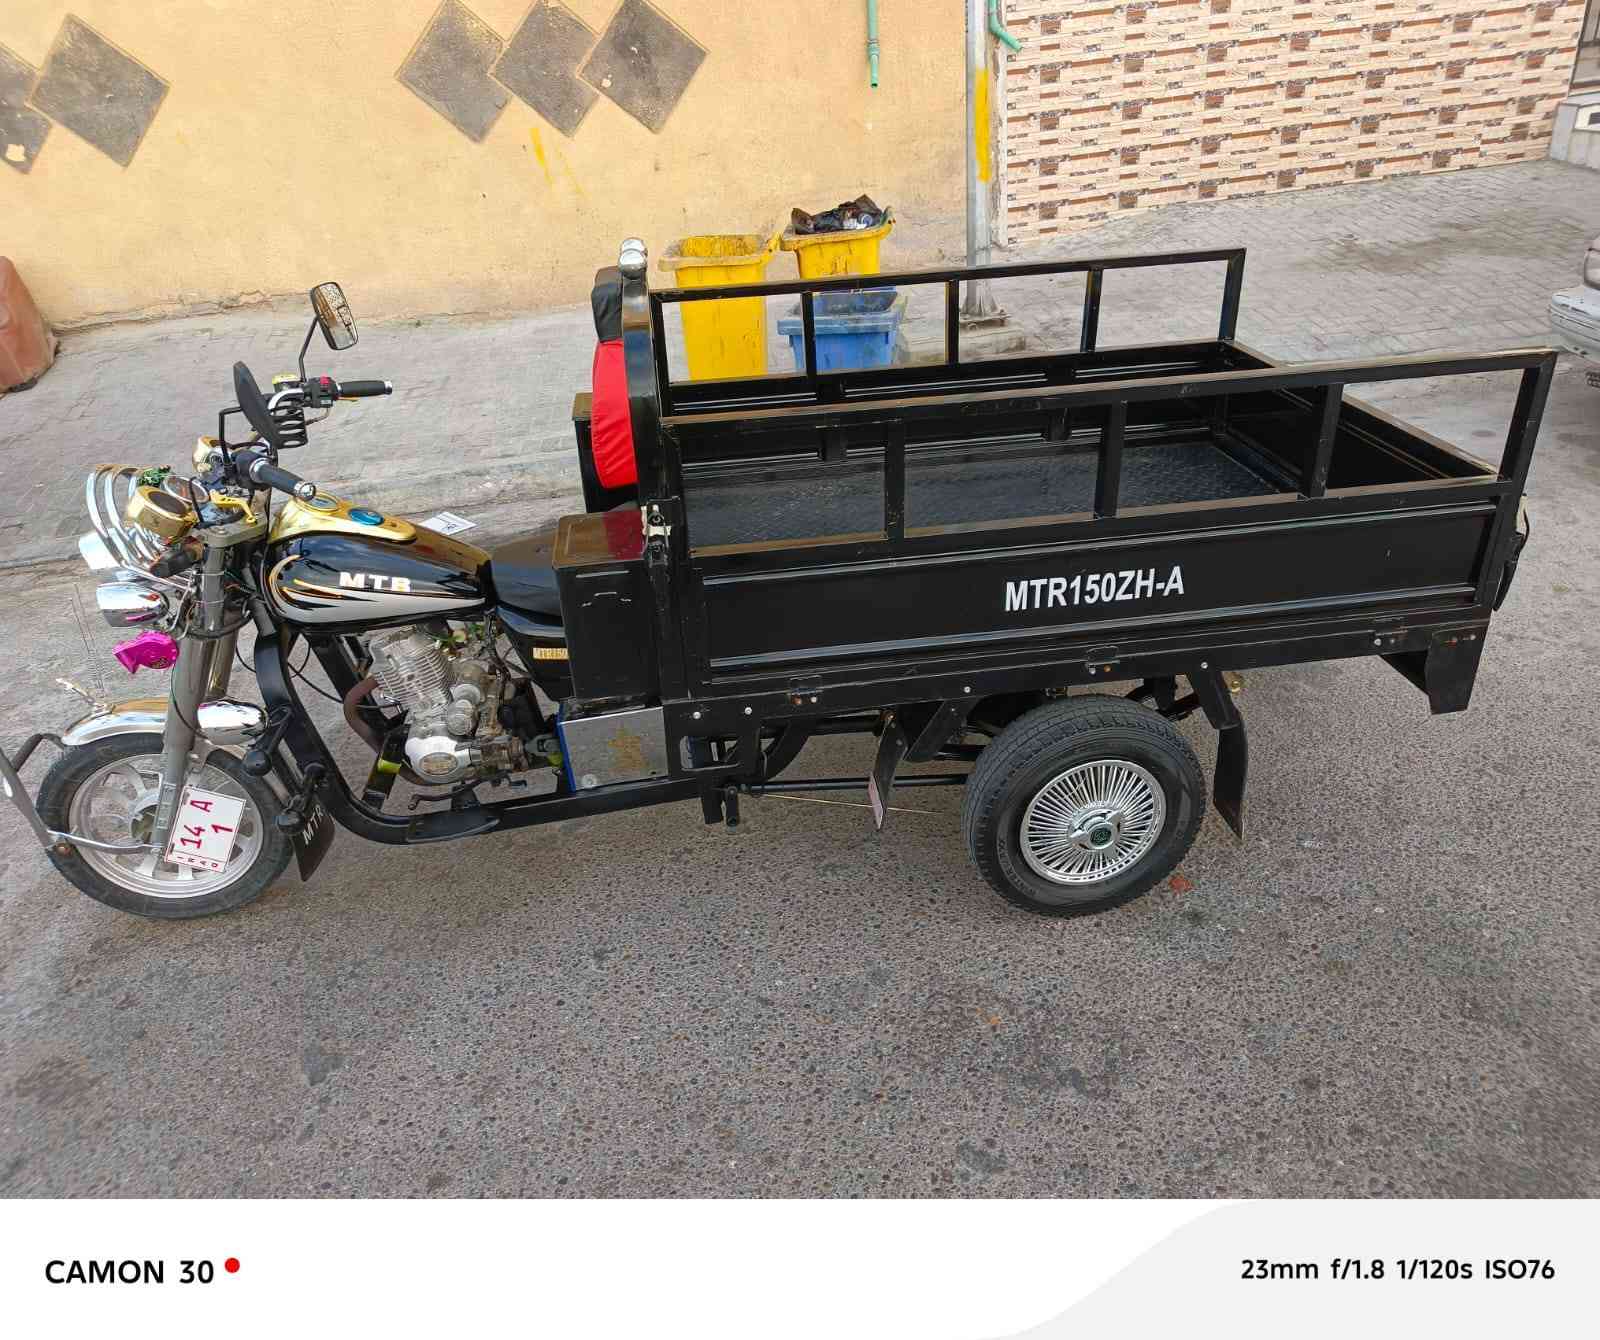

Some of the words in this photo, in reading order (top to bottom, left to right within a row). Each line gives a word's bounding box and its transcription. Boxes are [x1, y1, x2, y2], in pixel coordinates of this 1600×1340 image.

[339, 571, 412, 593] MTR
[1004, 565, 1185, 612] MTR150ZH-A
[190, 800, 213, 813] A
[180, 825, 205, 849] 14
[211, 824, 233, 833] 1
